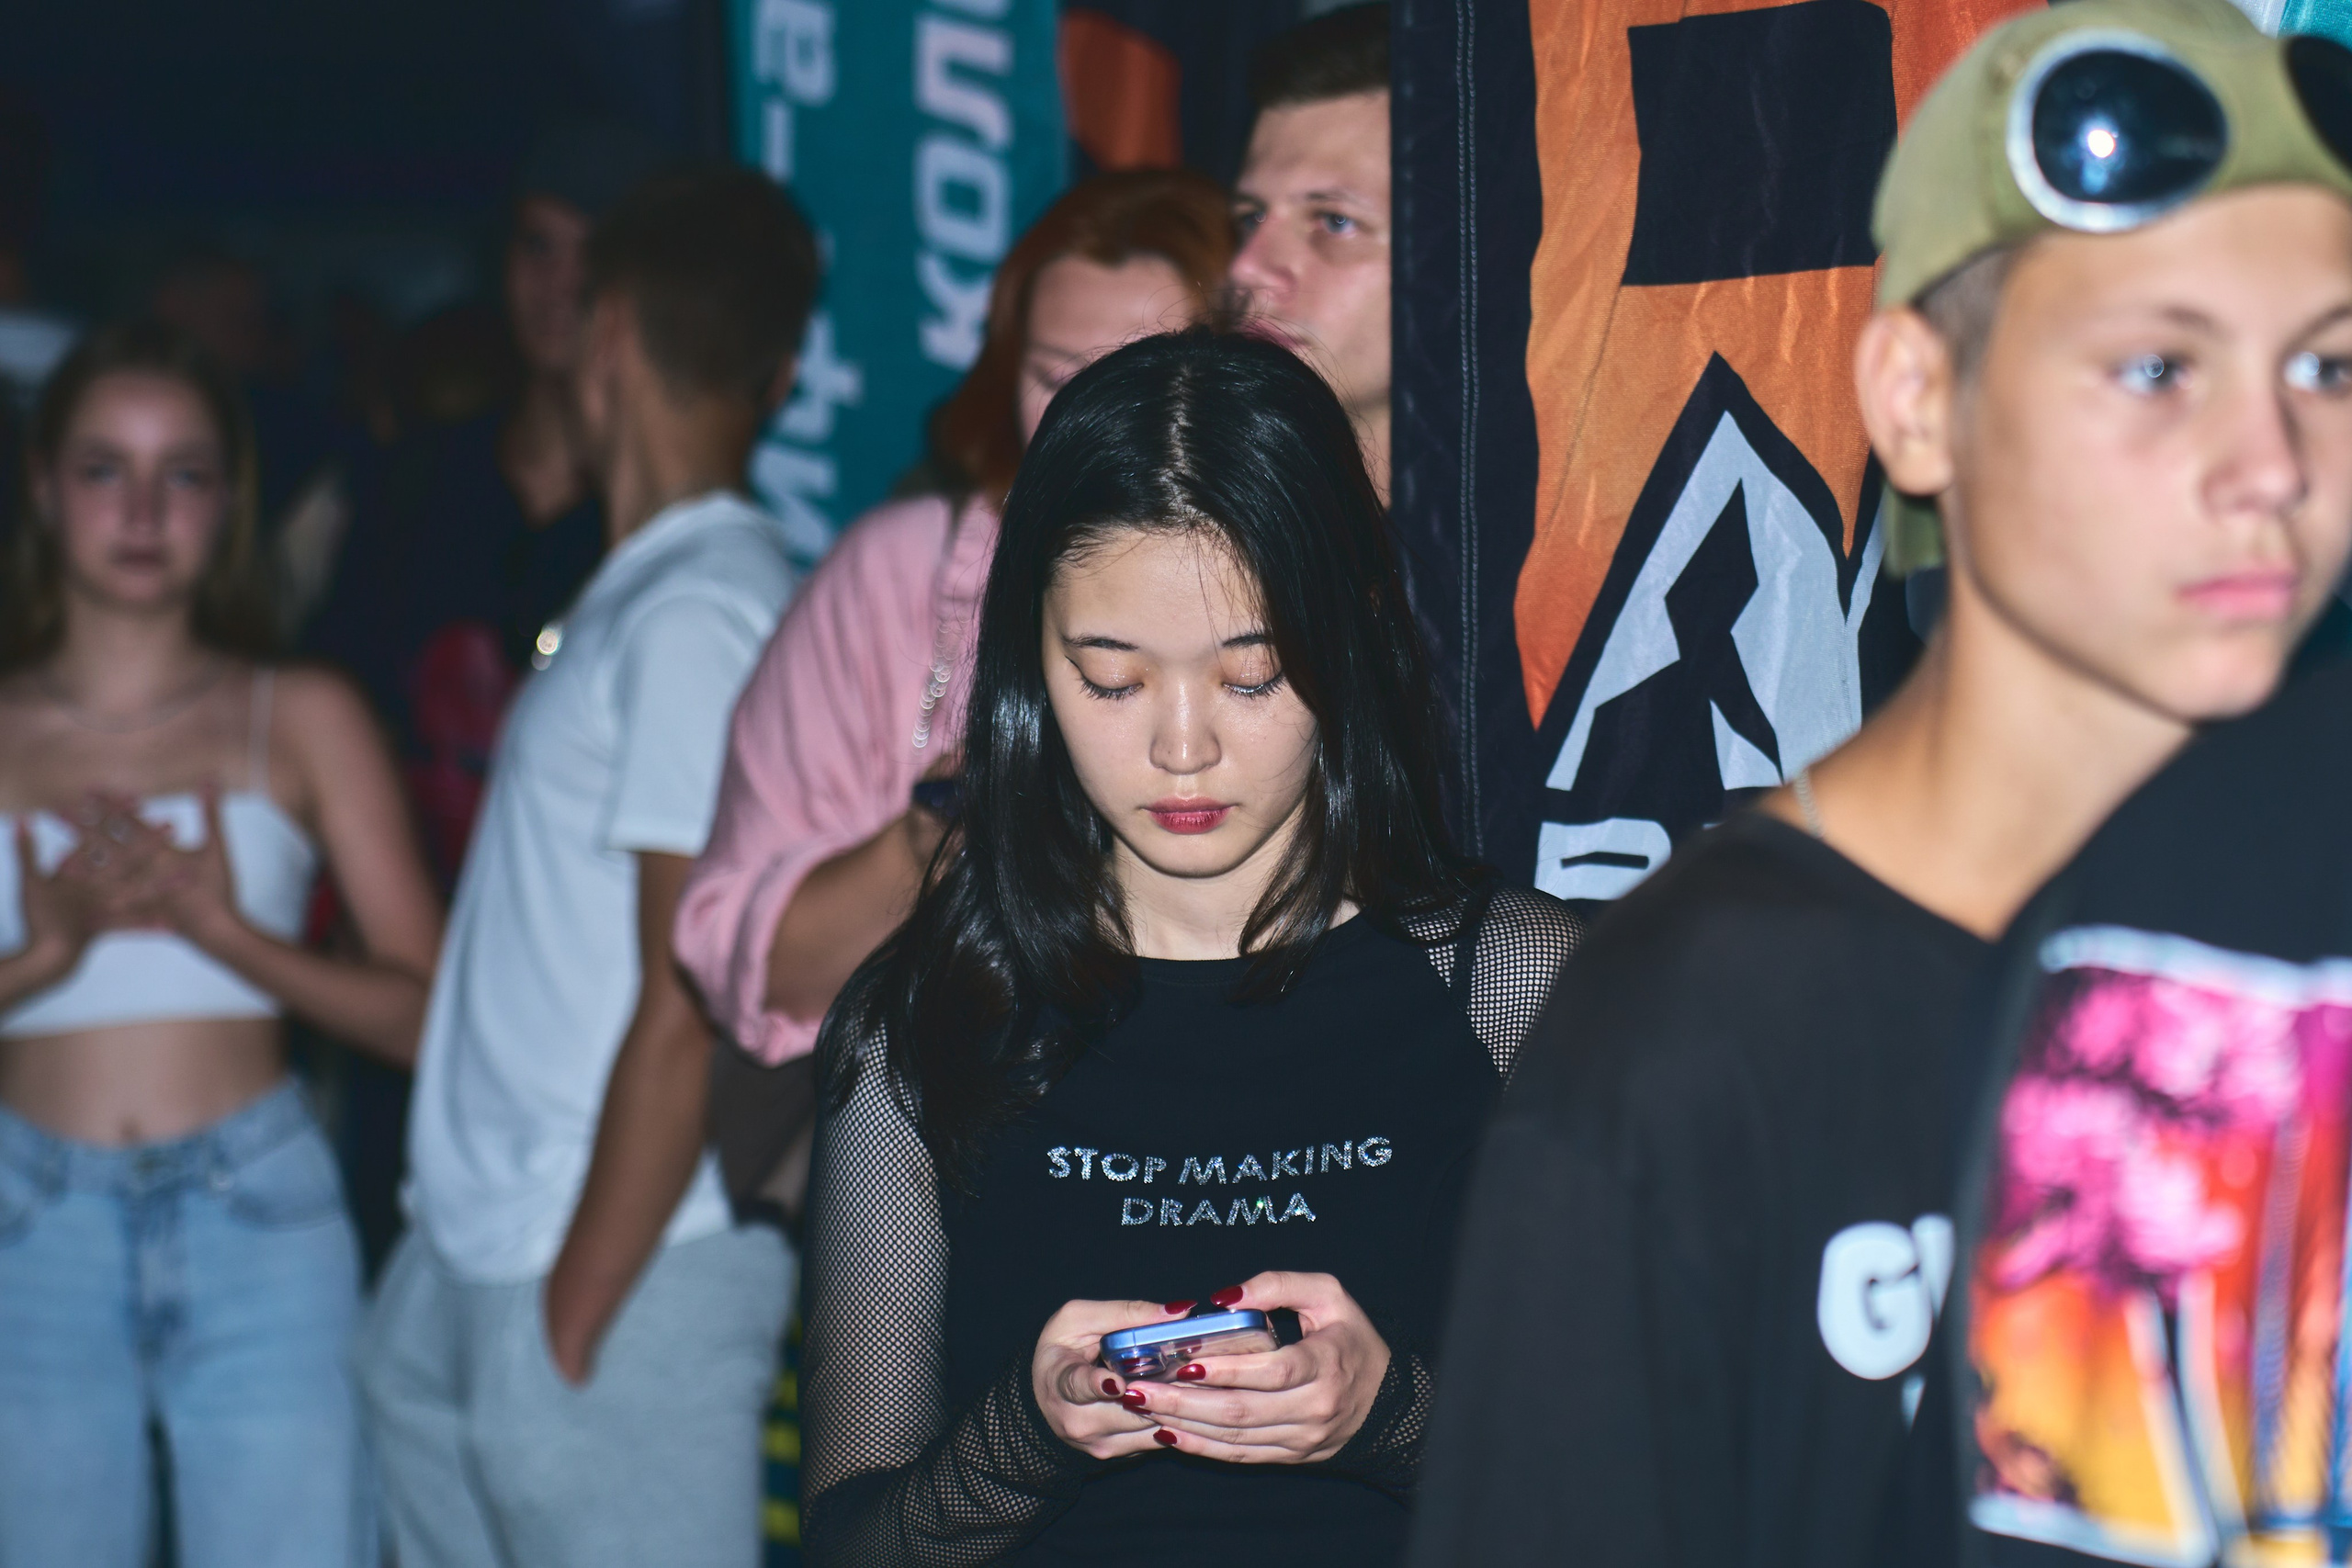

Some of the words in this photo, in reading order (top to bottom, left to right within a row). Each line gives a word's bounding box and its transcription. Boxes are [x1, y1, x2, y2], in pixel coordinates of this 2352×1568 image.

[914, 0, 1012, 370] кол
[1046, 1145, 1167, 1184] STOP
[1177, 1136, 1393, 1185] MAKING
[1120, 1192, 1317, 1227] DRAMA
